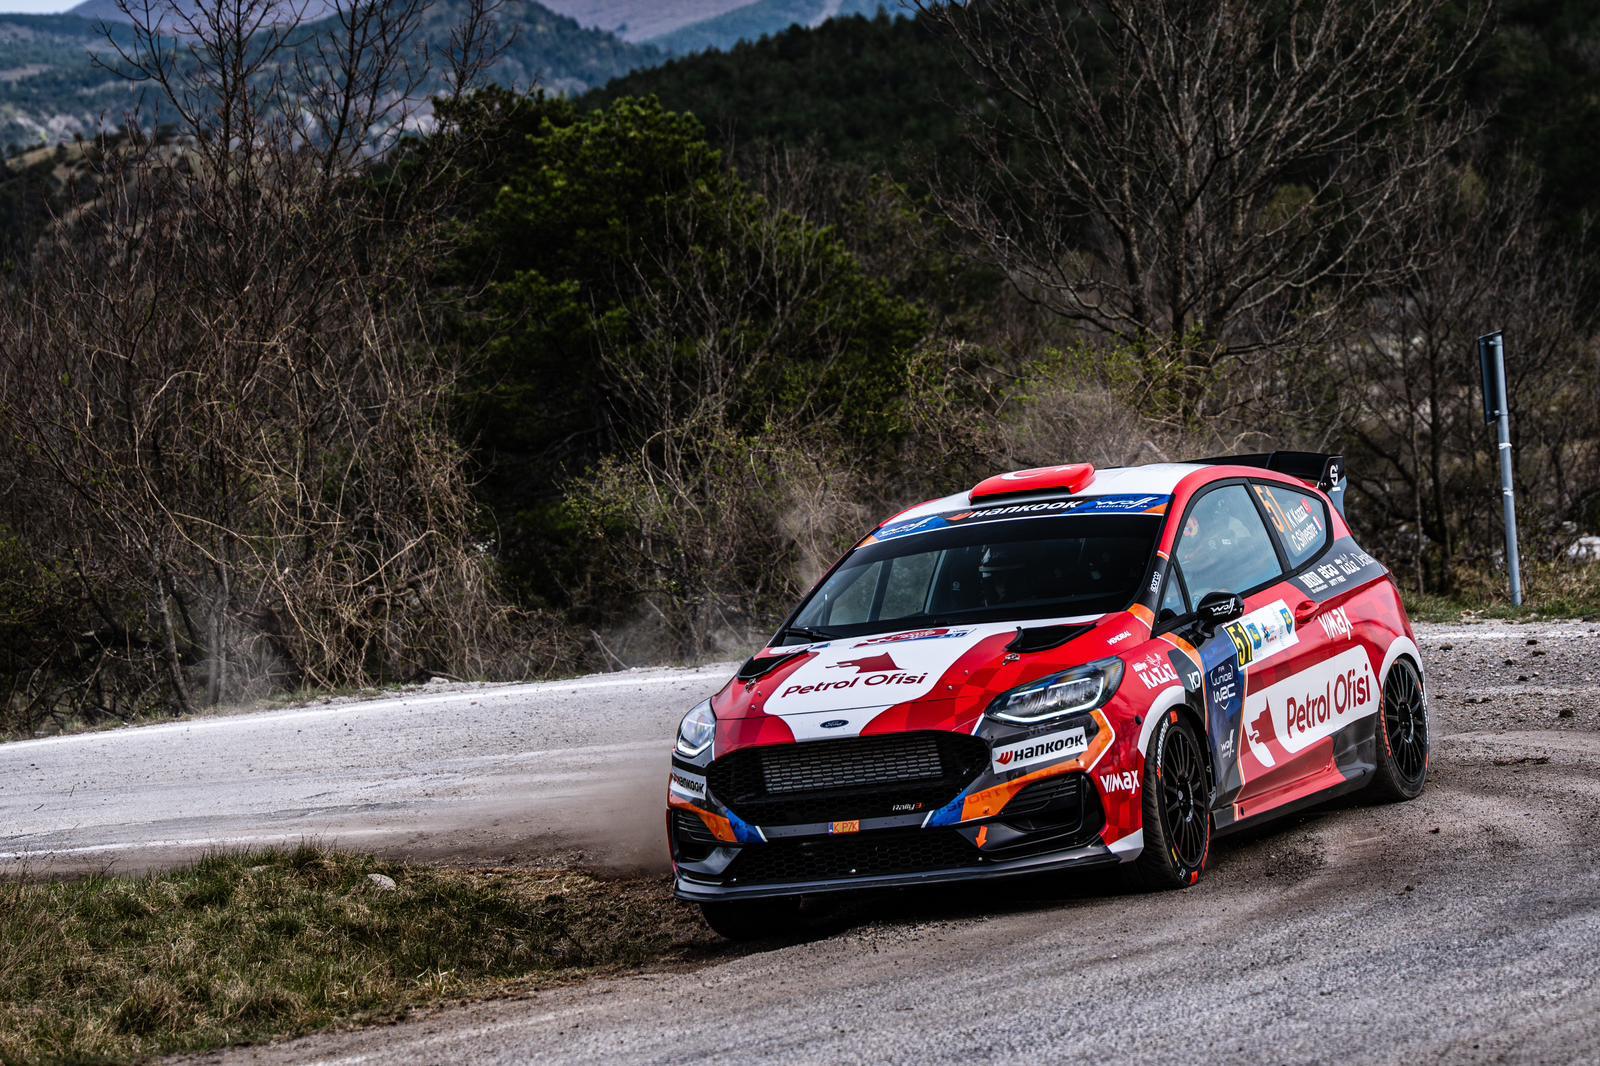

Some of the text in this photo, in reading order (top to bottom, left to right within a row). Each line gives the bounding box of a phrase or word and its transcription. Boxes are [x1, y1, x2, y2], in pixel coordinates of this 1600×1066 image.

[1253, 486, 1292, 533] 51
[1227, 623, 1252, 665] 51
[780, 672, 928, 698] Petrol Ofisi
[1287, 680, 1331, 739] Petrol
[1334, 663, 1371, 715] Ofisi
